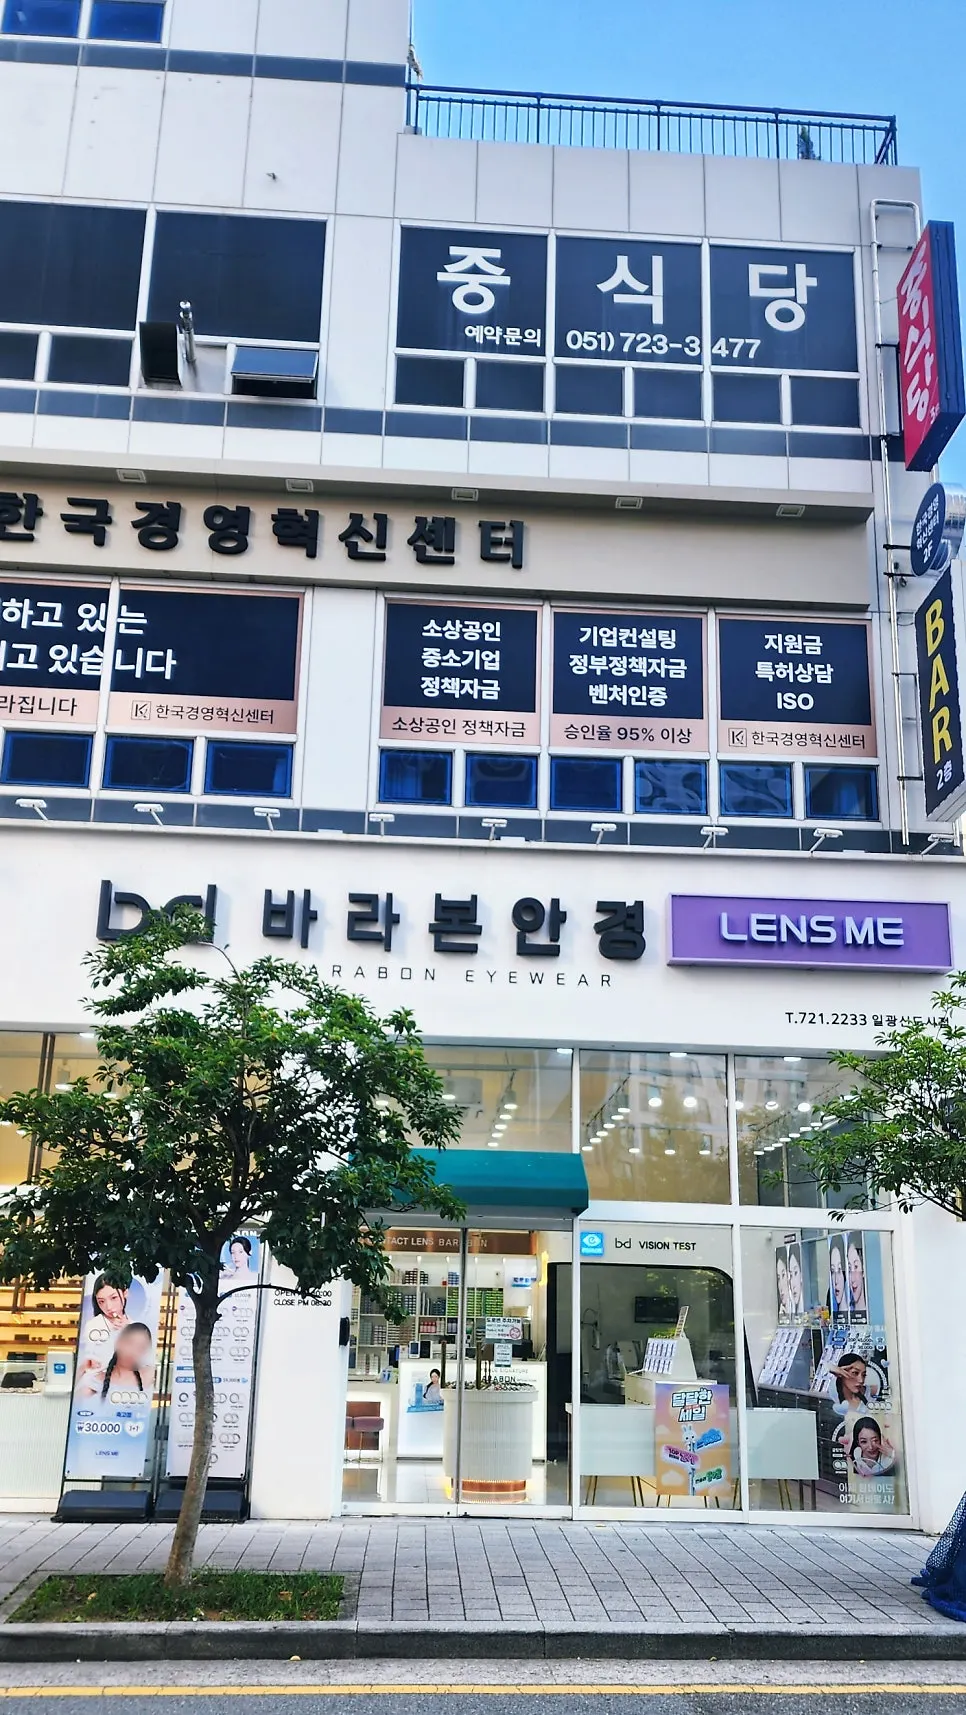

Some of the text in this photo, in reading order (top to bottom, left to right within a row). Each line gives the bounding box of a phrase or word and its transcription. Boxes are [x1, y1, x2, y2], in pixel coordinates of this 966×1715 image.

[464, 325, 541, 348] 예약문의
[566, 329, 614, 351] 051)
[0, 492, 524, 570] 한국경영혁신센터
[923, 540, 933, 564] 2F
[77, 603, 147, 634] 있는
[421, 619, 501, 642] 소상공인
[579, 626, 677, 650] 기업컨설팅
[764, 633, 823, 655] 지원금
[48, 643, 177, 680] 있습니다
[421, 647, 500, 671] 중소기업
[568, 654, 687, 679] 정부정책자금
[755, 661, 834, 684] 특허상담
[925, 598, 952, 765] BAR
[420, 676, 500, 700] 정책자금
[588, 684, 668, 708] 벤처인증
[777, 692, 814, 711] ISO
[155, 704, 274, 725] 한국경영혁신센터
[391, 717, 526, 738] 소상공인 정책자금
[564, 724, 692, 744] 승인율 95% 이상
[752, 731, 866, 750] 한국경영혁신센터
[936, 759, 953, 791] 2층
[720, 912, 904, 946] LENS ME
[306, 964, 611, 987] ARABON EYEWEAR
[785, 1012, 867, 1026] T.721.2233
[411, 1237, 434, 1246] LENS
[639, 1241, 670, 1250] VISION
[673, 1242, 697, 1251] TEST
[274, 1298, 295, 1306] CLOSE
